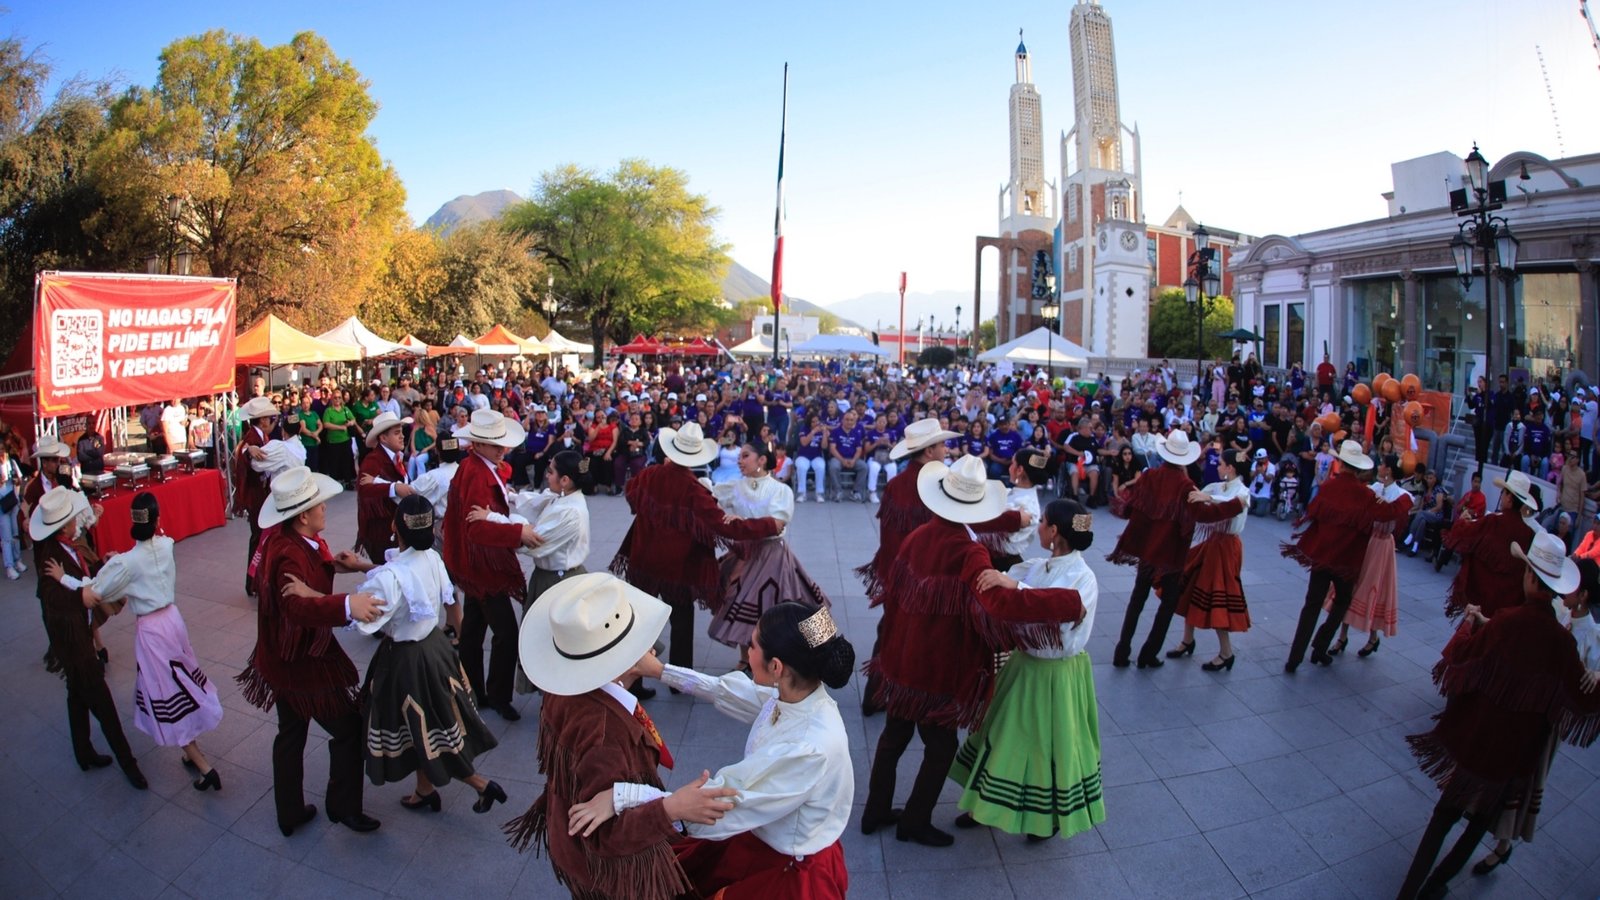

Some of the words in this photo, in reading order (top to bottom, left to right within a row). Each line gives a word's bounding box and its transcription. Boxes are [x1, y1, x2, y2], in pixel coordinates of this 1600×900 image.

[108, 308, 133, 328] NO
[134, 308, 192, 327] HAGAS
[193, 307, 227, 325] FILA
[108, 333, 149, 353] PIDE
[150, 331, 174, 350] EN
[174, 326, 220, 349] LÍNEA
[108, 360, 122, 379] Y
[122, 354, 190, 378] RECOGE
